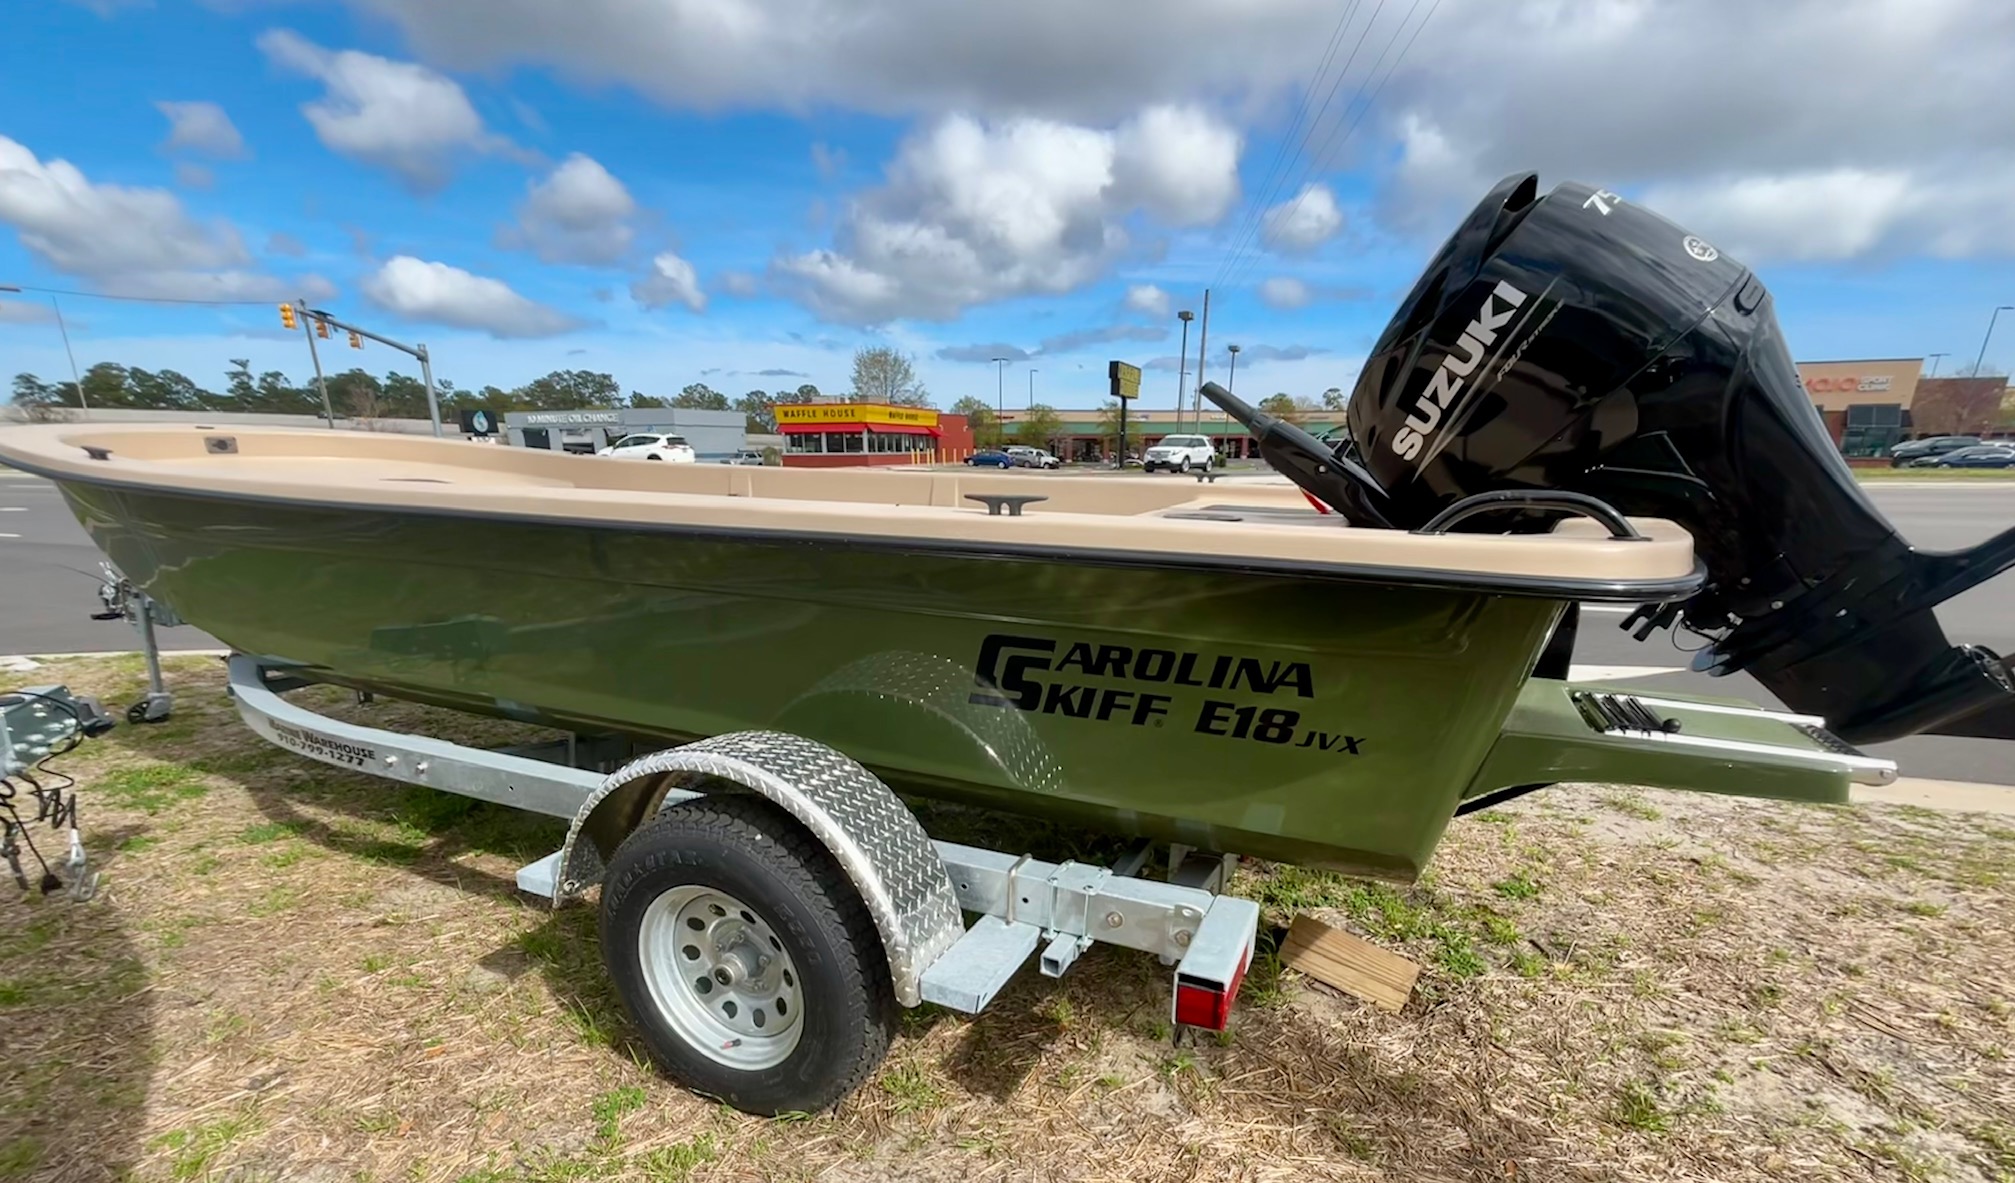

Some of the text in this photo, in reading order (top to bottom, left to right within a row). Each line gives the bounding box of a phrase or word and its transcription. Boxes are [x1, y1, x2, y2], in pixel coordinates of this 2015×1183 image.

[1391, 280, 1528, 461] SUZUKI
[582, 412, 618, 423] CHANGE
[783, 409, 856, 418] WAFFLE HOUSE
[973, 633, 1315, 699] CAROLINA
[968, 647, 1367, 755] SKIFF E18 JVX
[277, 733, 365, 767] 910-799-1277
[300, 729, 376, 760] WAREHOUSE
